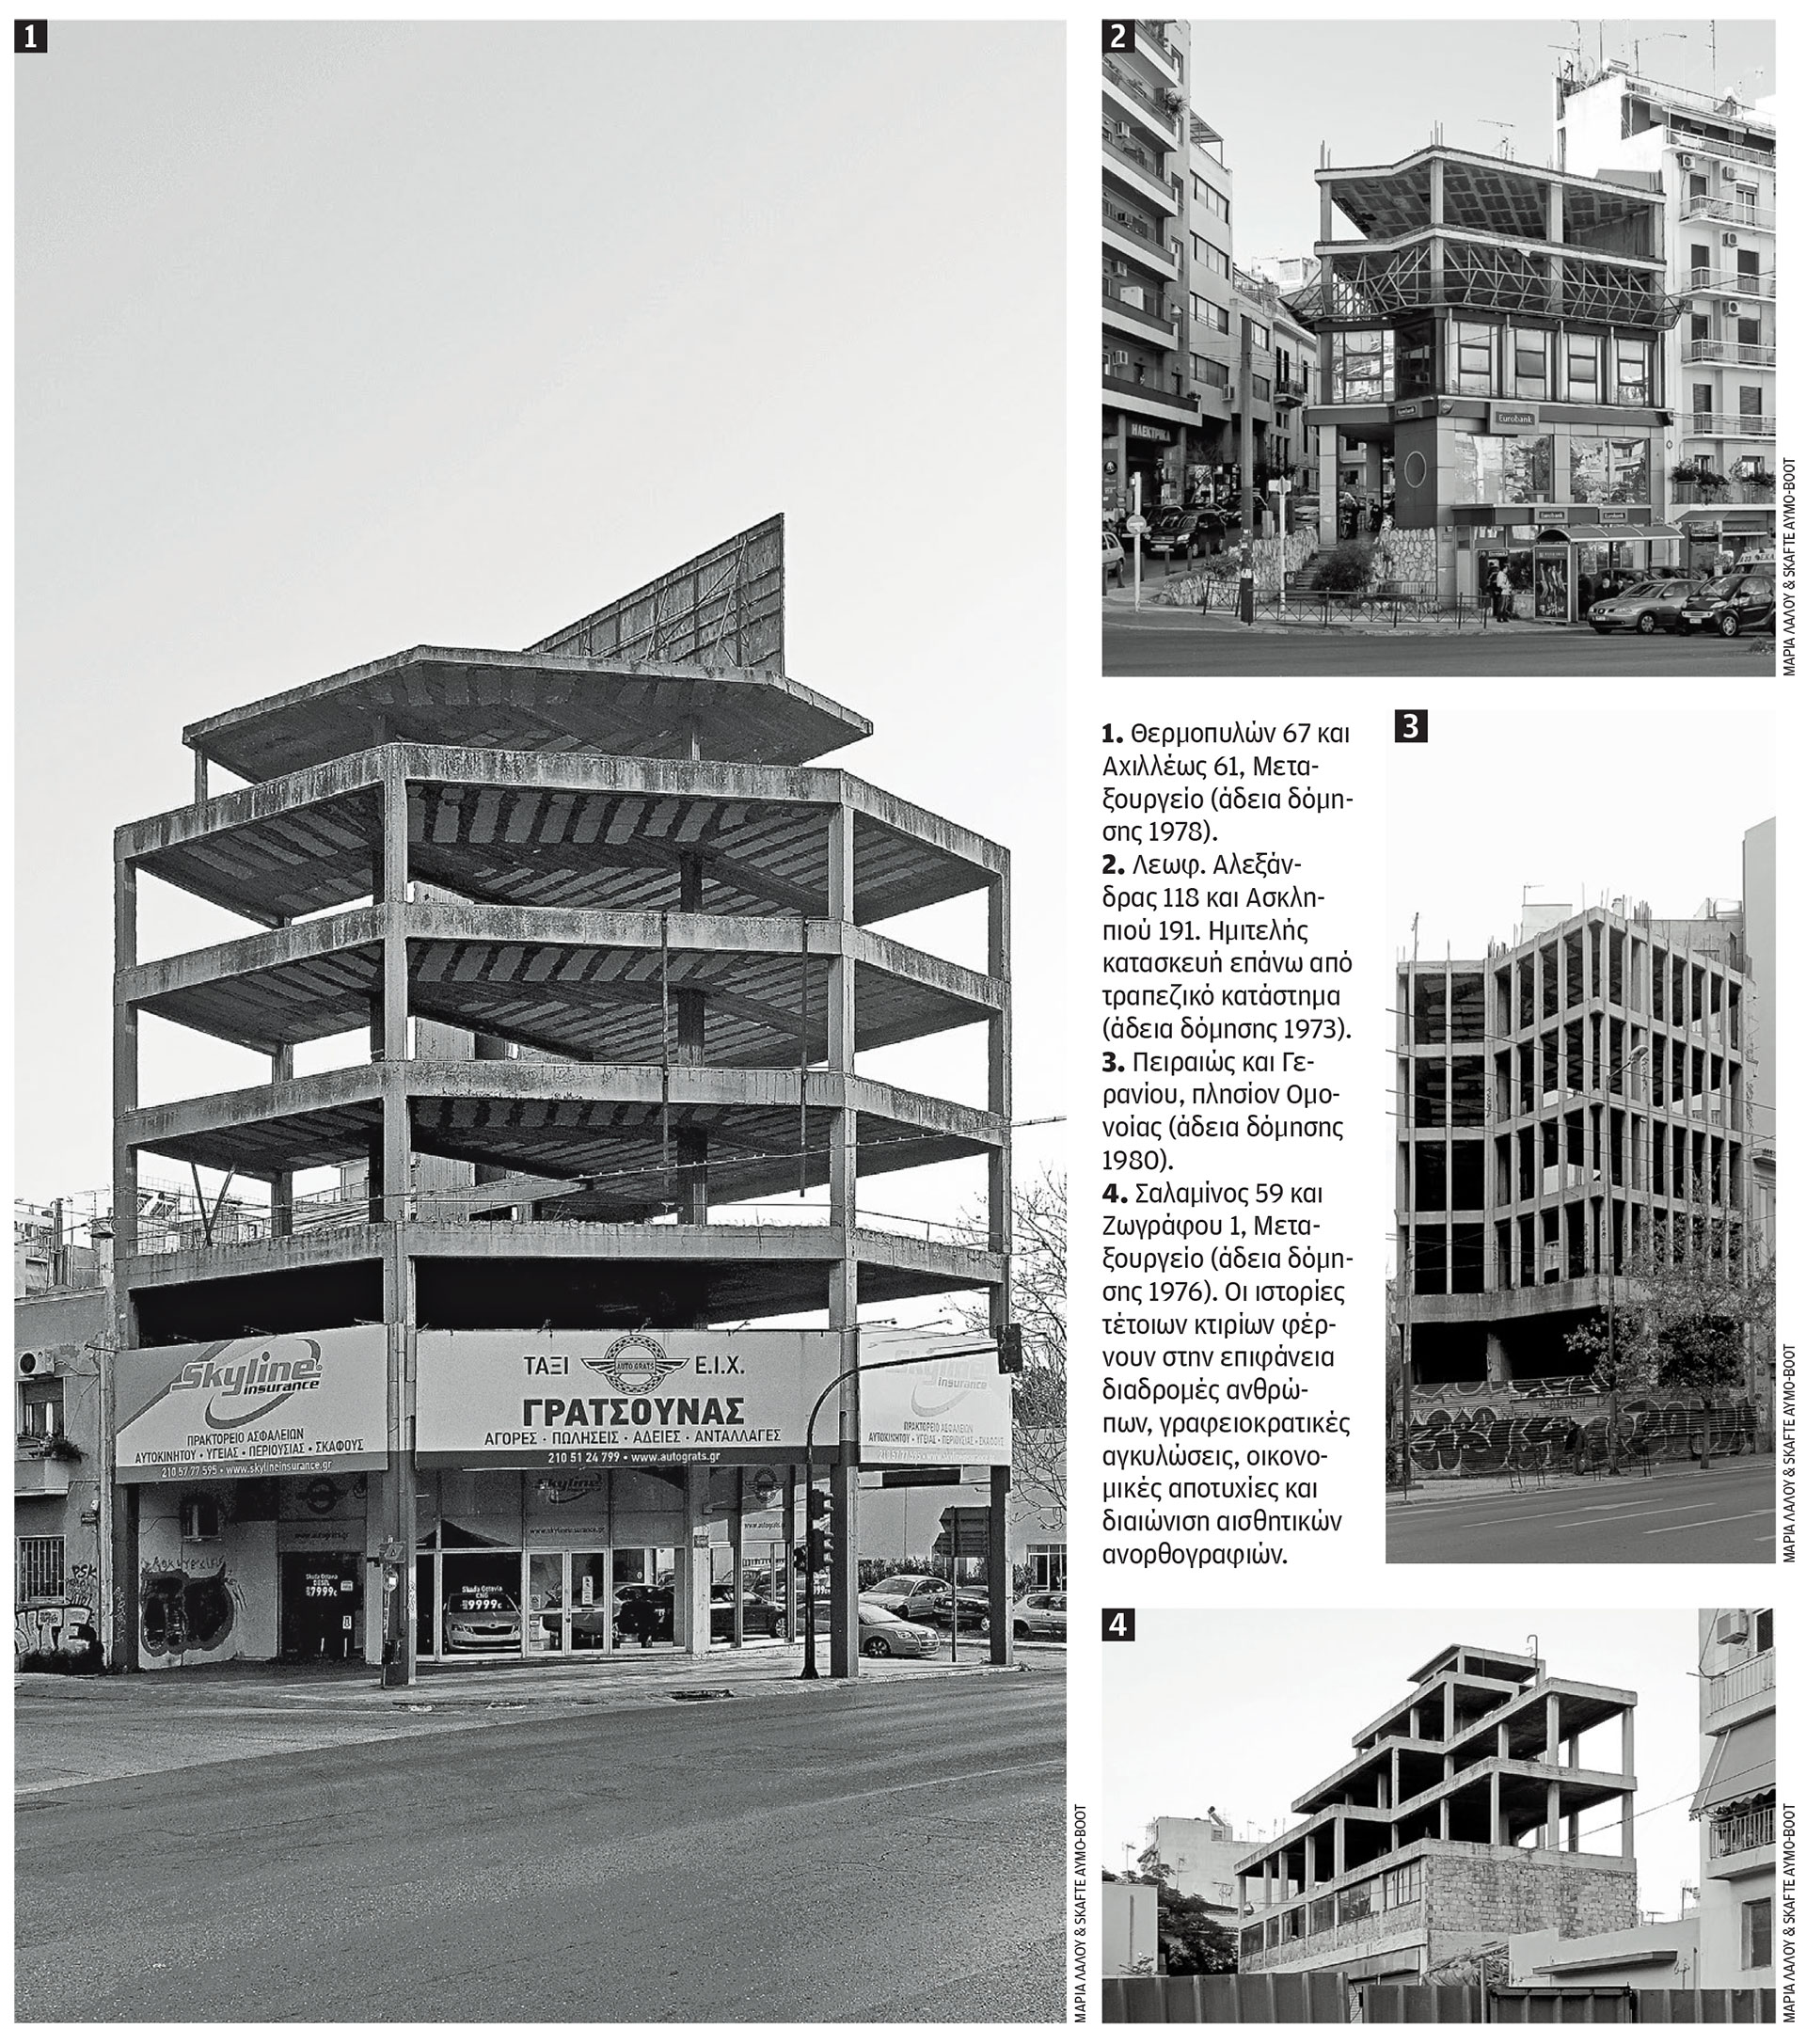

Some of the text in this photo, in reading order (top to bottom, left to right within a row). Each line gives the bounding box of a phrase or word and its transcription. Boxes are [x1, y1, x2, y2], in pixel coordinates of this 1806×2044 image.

[1498, 414, 1533, 424] Eurobank
[1132, 423, 1171, 442] ΗΛΕΚΤΡΙΚΑ
[523, 1355, 745, 1375] ΤΑΞΙ Ε.Ι.Χ.
[617, 1362, 655, 1371] AUTO GRATS
[171, 1352, 322, 1397] Skyline
[244, 1380, 320, 1395] insurance
[938, 1377, 988, 1390] insurance
[523, 1397, 745, 1426] ΓΡΑΤΣΟΥΝΑΣ
[187, 1428, 304, 1447] ΠΡΑΚΤΟΡΕΙΟ ΑΣΦΑΛΕΙΩΝ
[484, 1429, 782, 1446] ΑΓΟΡΕΣ ΠΩΛΗΣΕΙΣ ΑΔΕΙΕΣ ΑΝΤΑΛΛΑΓΕΣ
[135, 1438, 364, 1464] ΑΥΤΟΚΙΝΗΤΟΥ ΥΓΕΙΑΣ ΠΕΡΙΟΥΣΙΑΣ ΣΚΑΦΟΥΣ
[547, 1450, 721, 1464] 210 51 24 799 www.autograts.gr
[161, 1466, 177, 1478] 210
[201, 1465, 217, 1476] 595
[225, 1461, 332, 1475] www.skylineinsurance.gr
